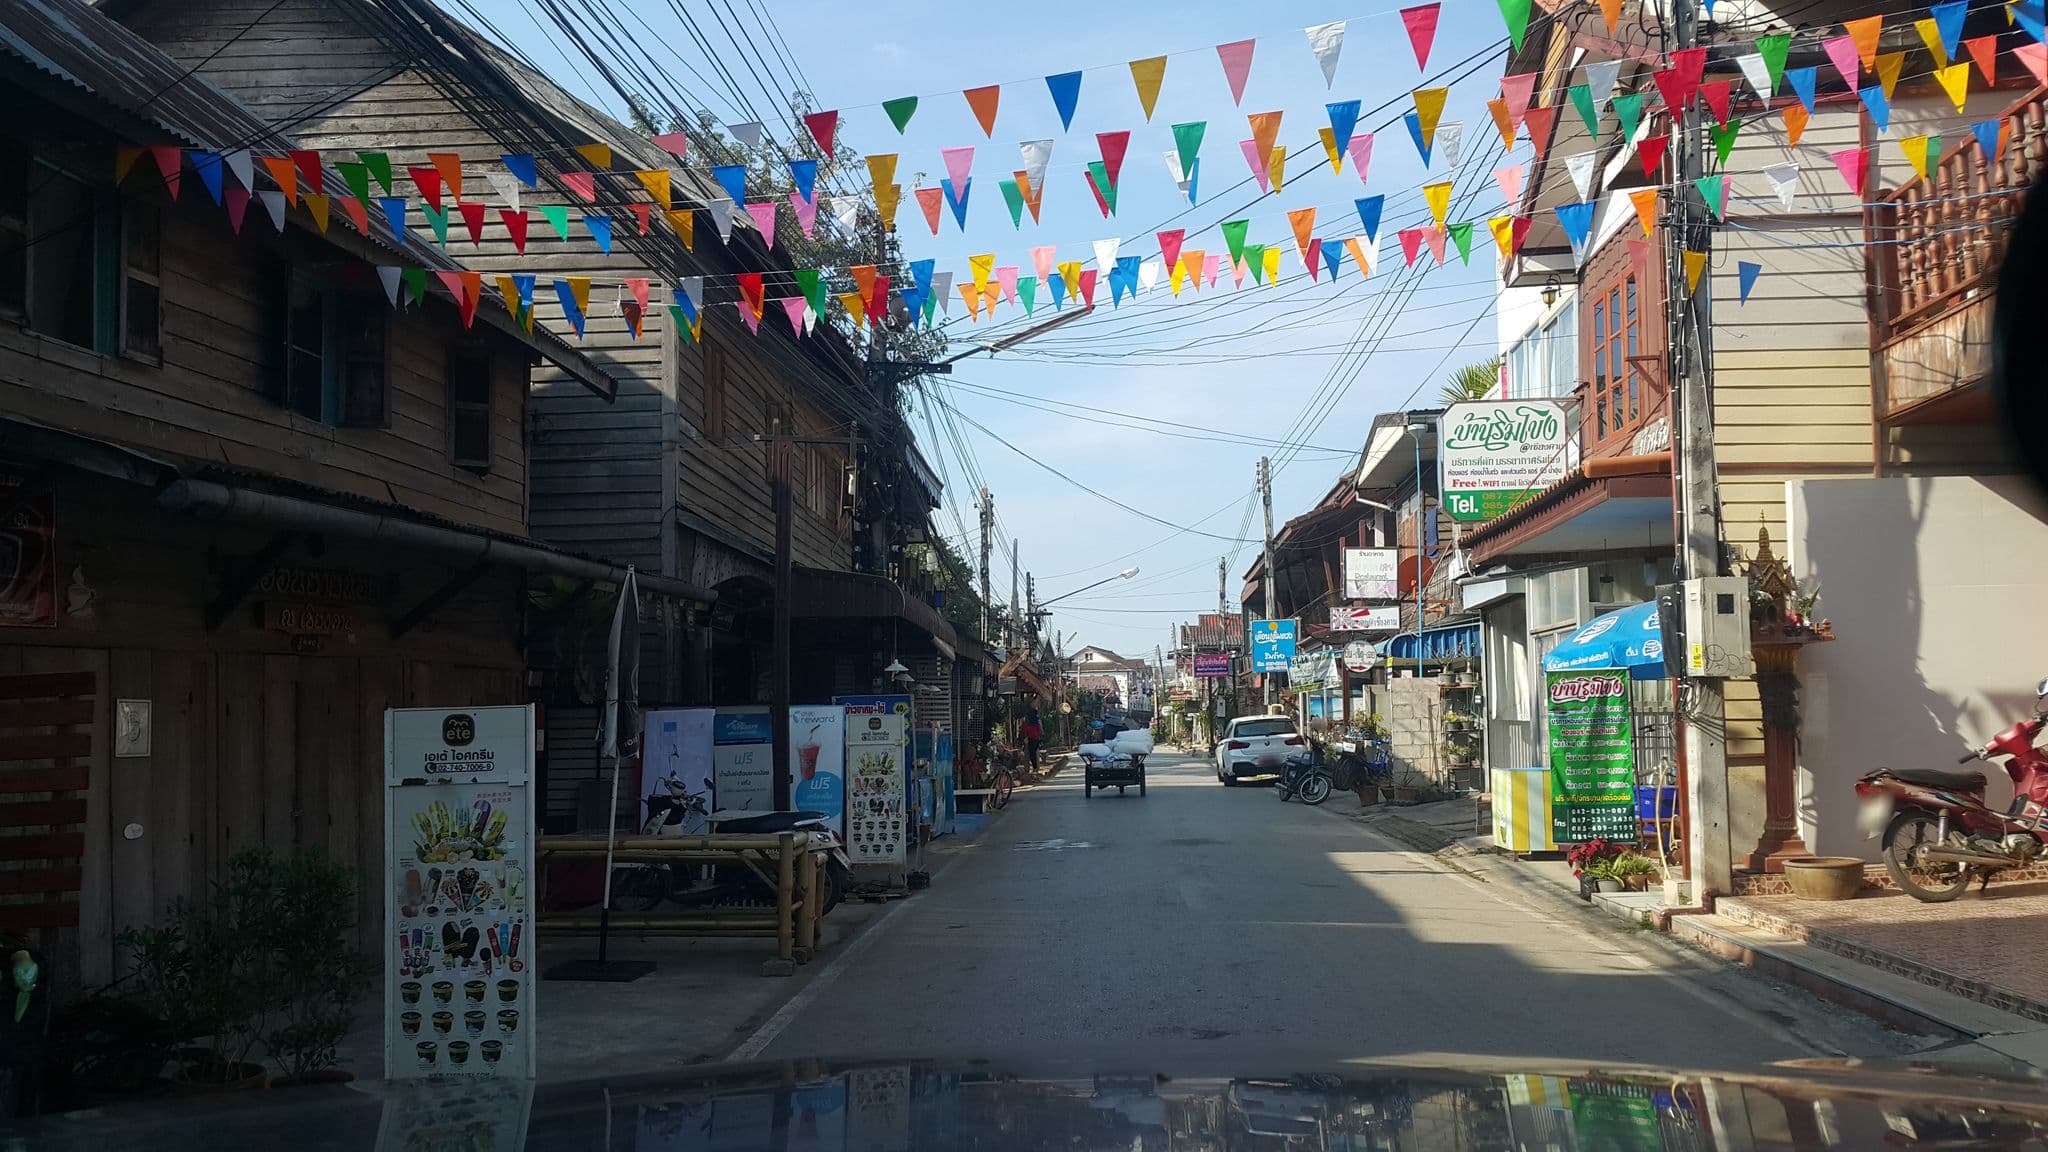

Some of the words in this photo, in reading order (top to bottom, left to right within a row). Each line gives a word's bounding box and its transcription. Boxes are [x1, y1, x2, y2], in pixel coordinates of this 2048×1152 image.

[1446, 405, 1558, 451] บ้านริมโขง
[1449, 495, 1479, 514] Tel.
[1551, 675, 1625, 703] บ้านริมโขง
[800, 715, 836, 723] reward
[424, 750, 448, 762] เอเต้
[451, 749, 494, 762] ไอศกรีม
[810, 777, 831, 790] ฟรี
